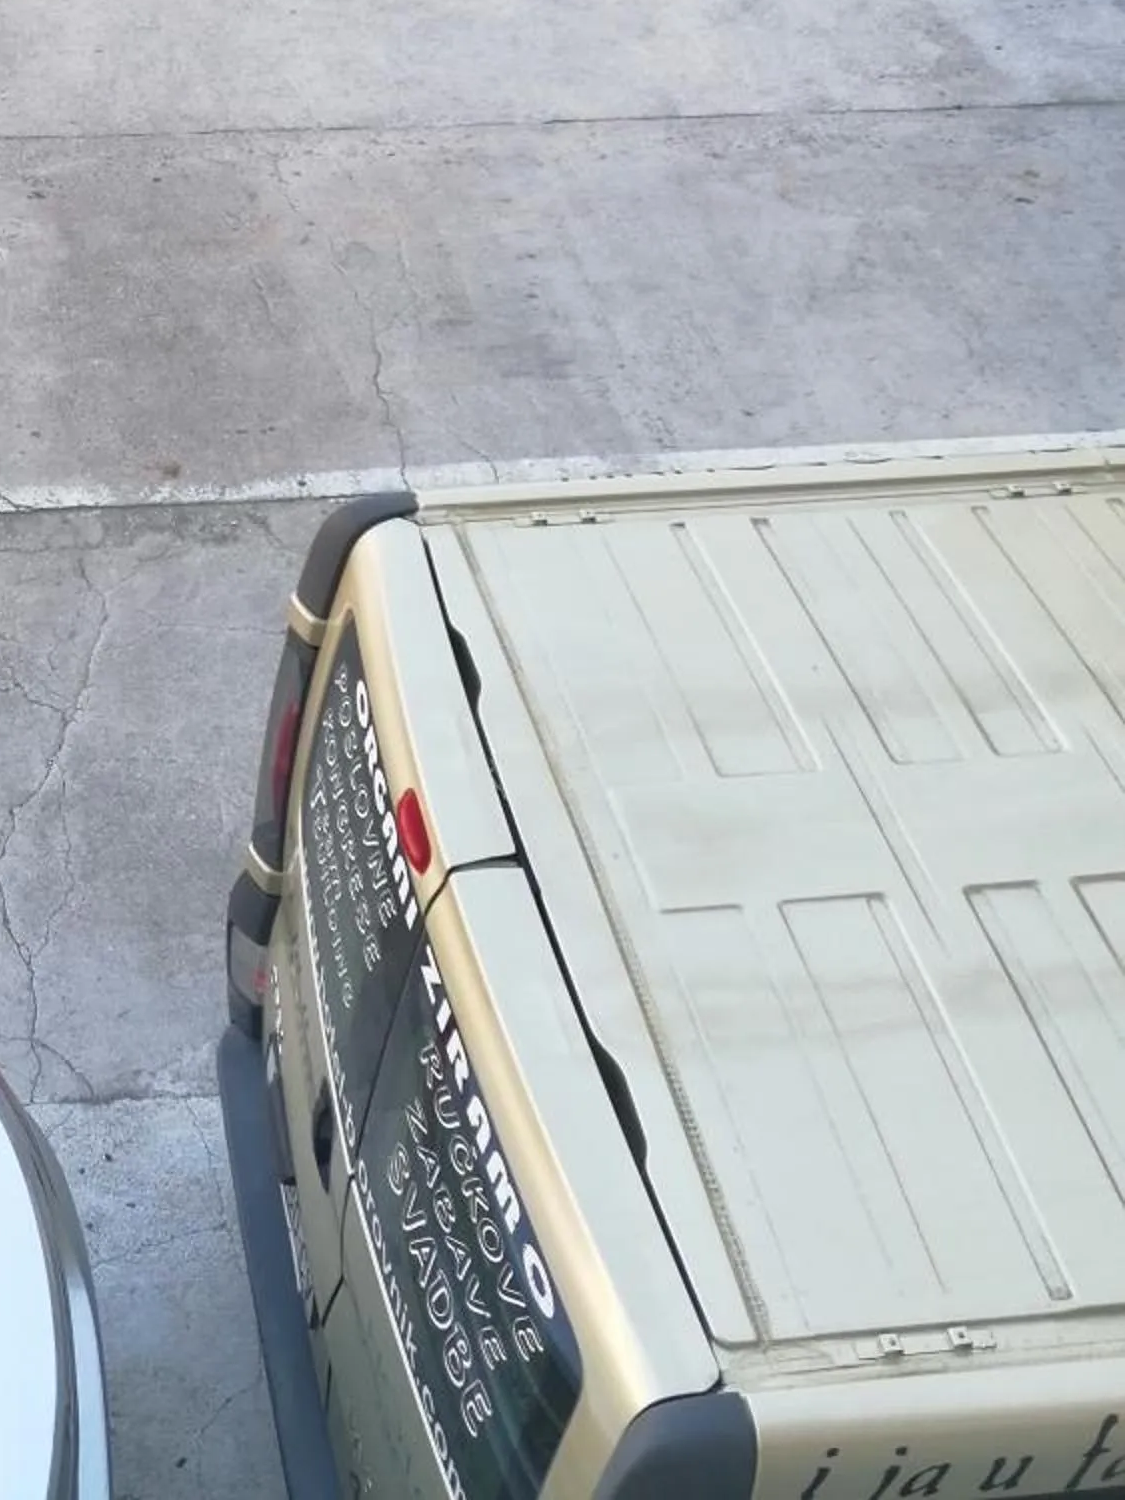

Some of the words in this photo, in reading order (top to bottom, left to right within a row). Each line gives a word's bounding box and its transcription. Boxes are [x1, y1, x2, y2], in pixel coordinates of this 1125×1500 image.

[334, 660, 399, 928] POSLOVNE
[386, 1141, 494, 1439] SVADBE
[403, 1099, 508, 1372] ZABAVE
